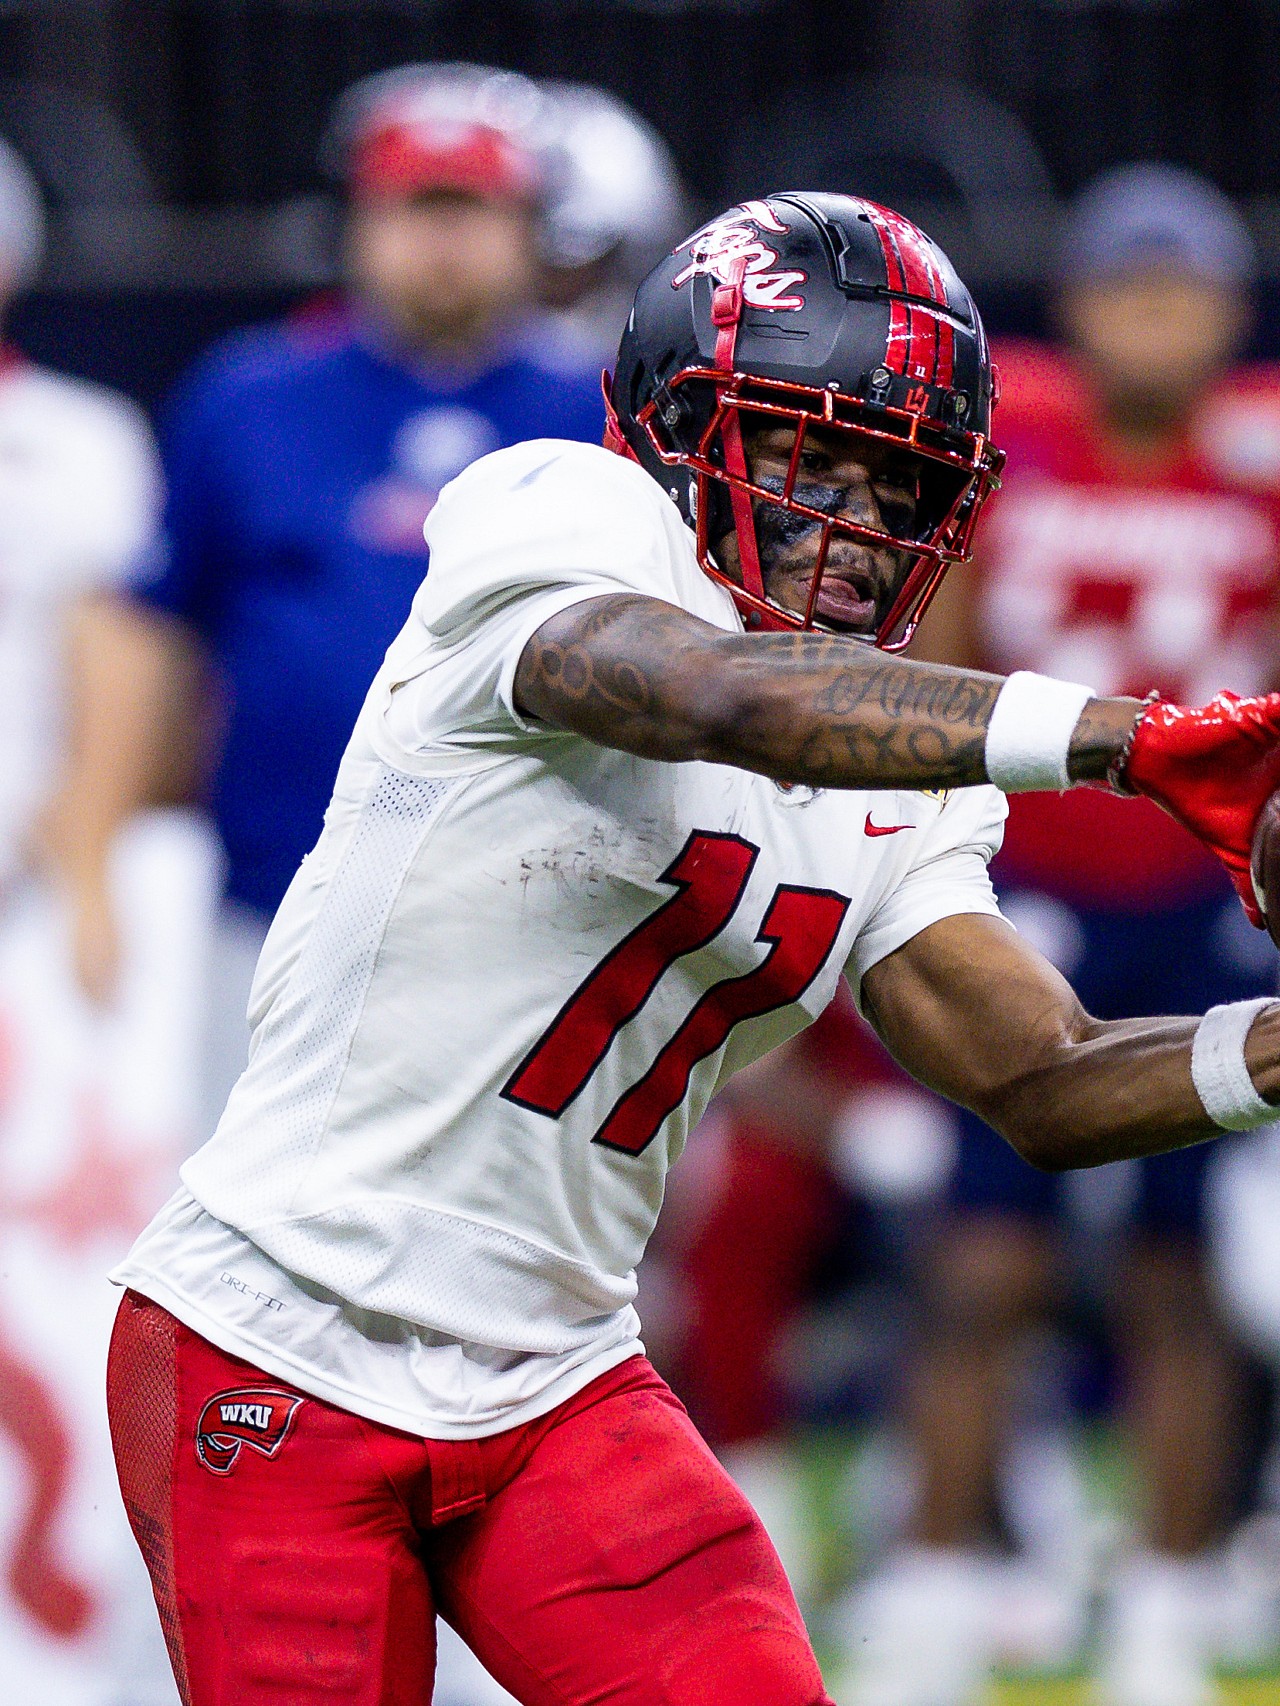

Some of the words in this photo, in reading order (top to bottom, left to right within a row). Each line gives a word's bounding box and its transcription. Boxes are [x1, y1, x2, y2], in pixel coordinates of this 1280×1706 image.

[499, 828, 852, 1157] 11
[220, 1272, 287, 1311] DRI-FIT
[220, 1404, 273, 1429] WKU
